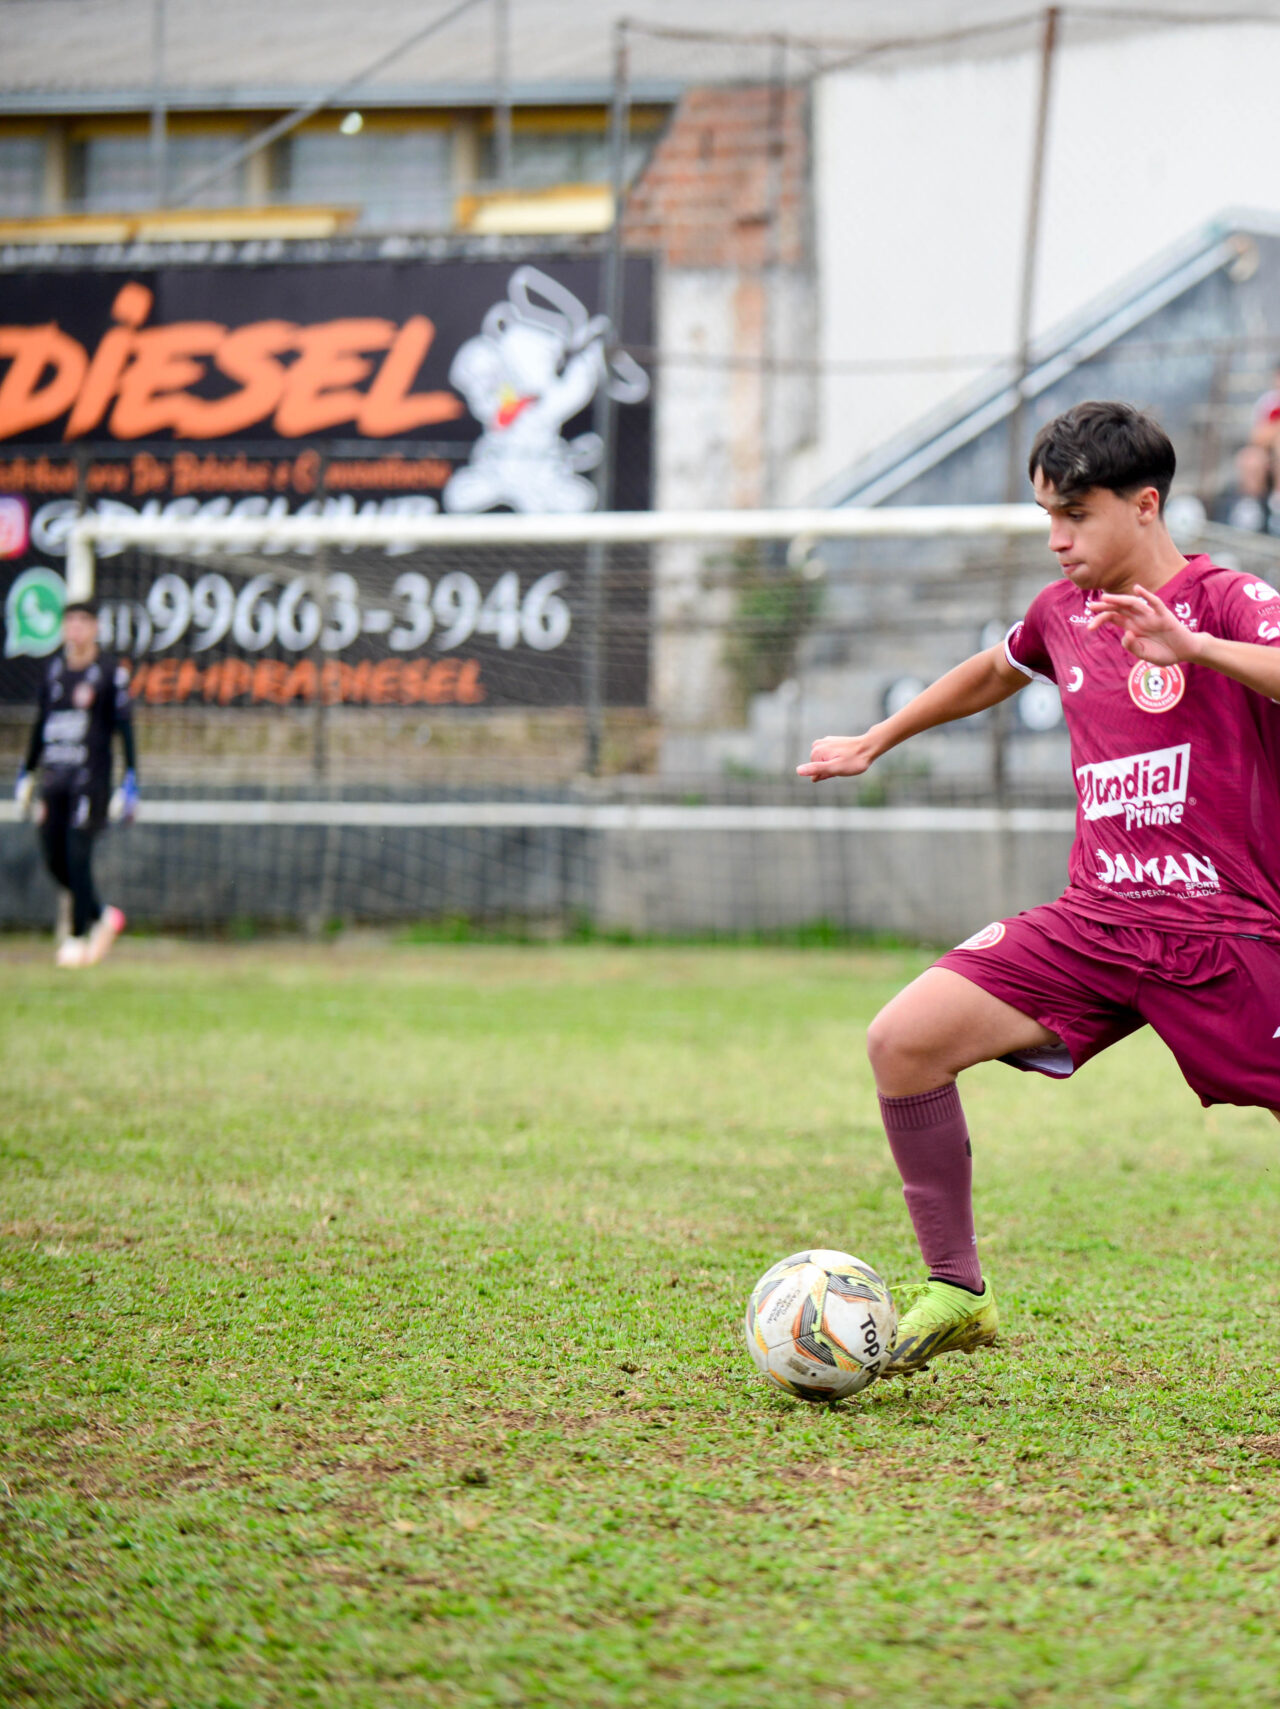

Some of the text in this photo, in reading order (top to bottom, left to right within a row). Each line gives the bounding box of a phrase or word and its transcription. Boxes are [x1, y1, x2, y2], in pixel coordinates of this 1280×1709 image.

[146, 572, 572, 652] 99663-3946
[1079, 752, 1182, 809] Mundial
[1123, 802, 1184, 831] Prime
[1096, 848, 1219, 885] DAMAN
[1185, 881, 1220, 890] SPORTS
